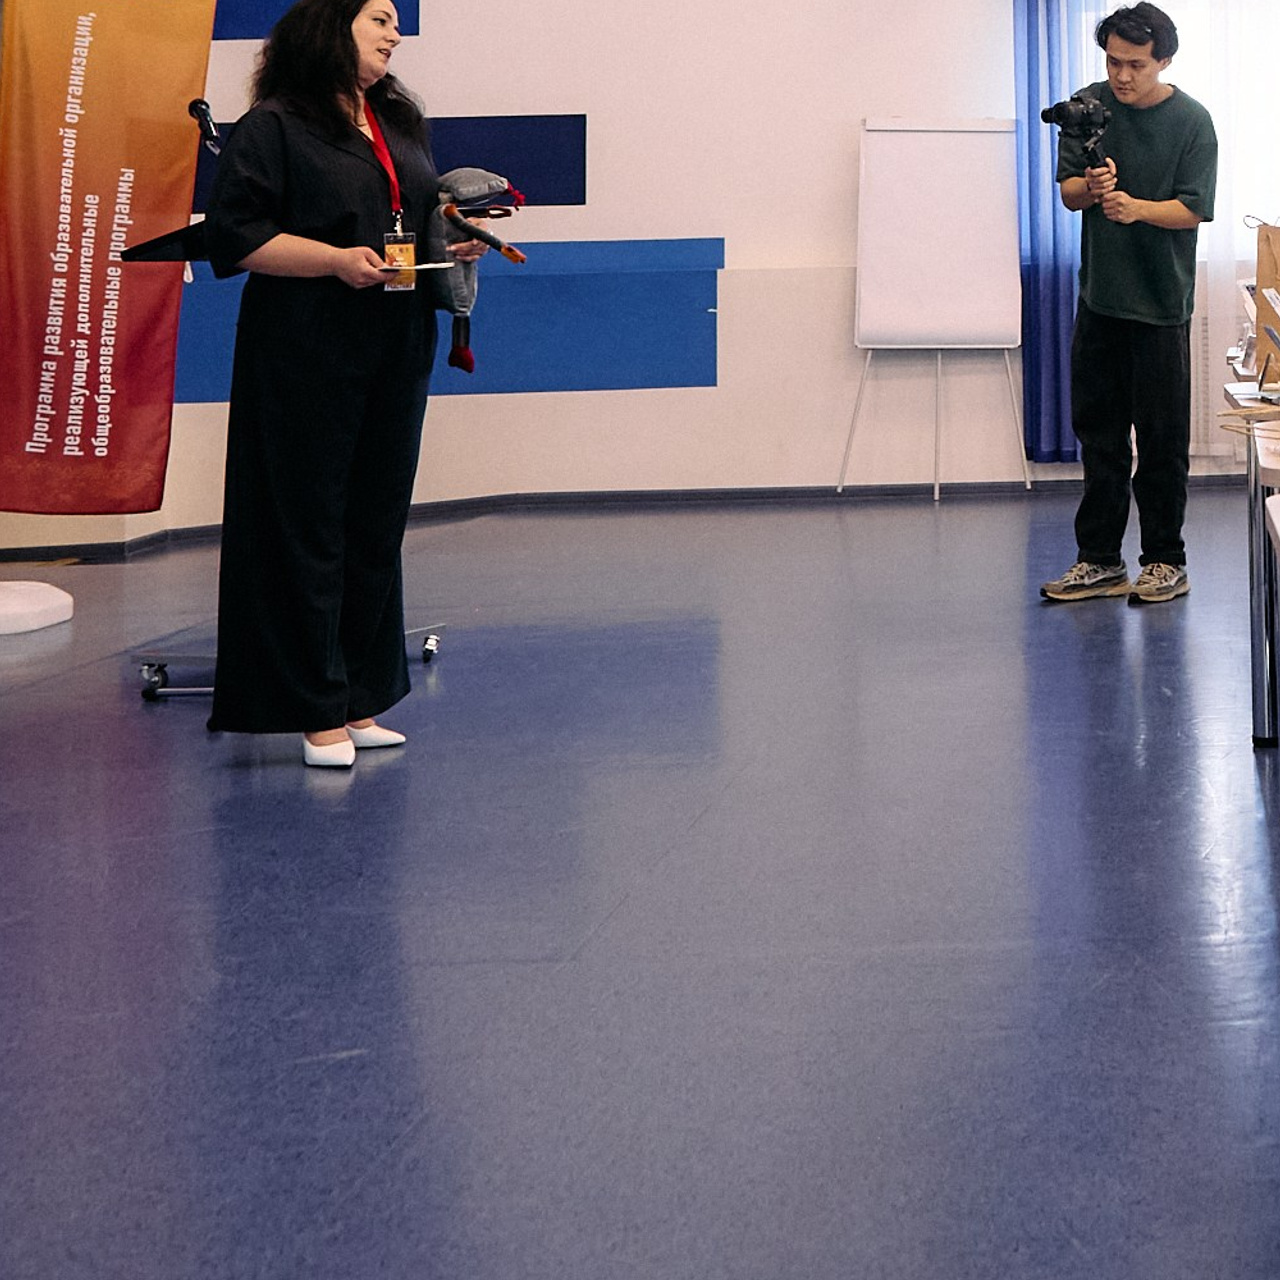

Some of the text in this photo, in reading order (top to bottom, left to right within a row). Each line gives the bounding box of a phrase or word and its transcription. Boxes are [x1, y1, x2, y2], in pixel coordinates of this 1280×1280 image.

[25, 12, 97, 453] Программа развития образовательной организации,
[63, 194, 100, 456] реализующей дополнительные
[91, 168, 135, 456] общеобразовательные программы
